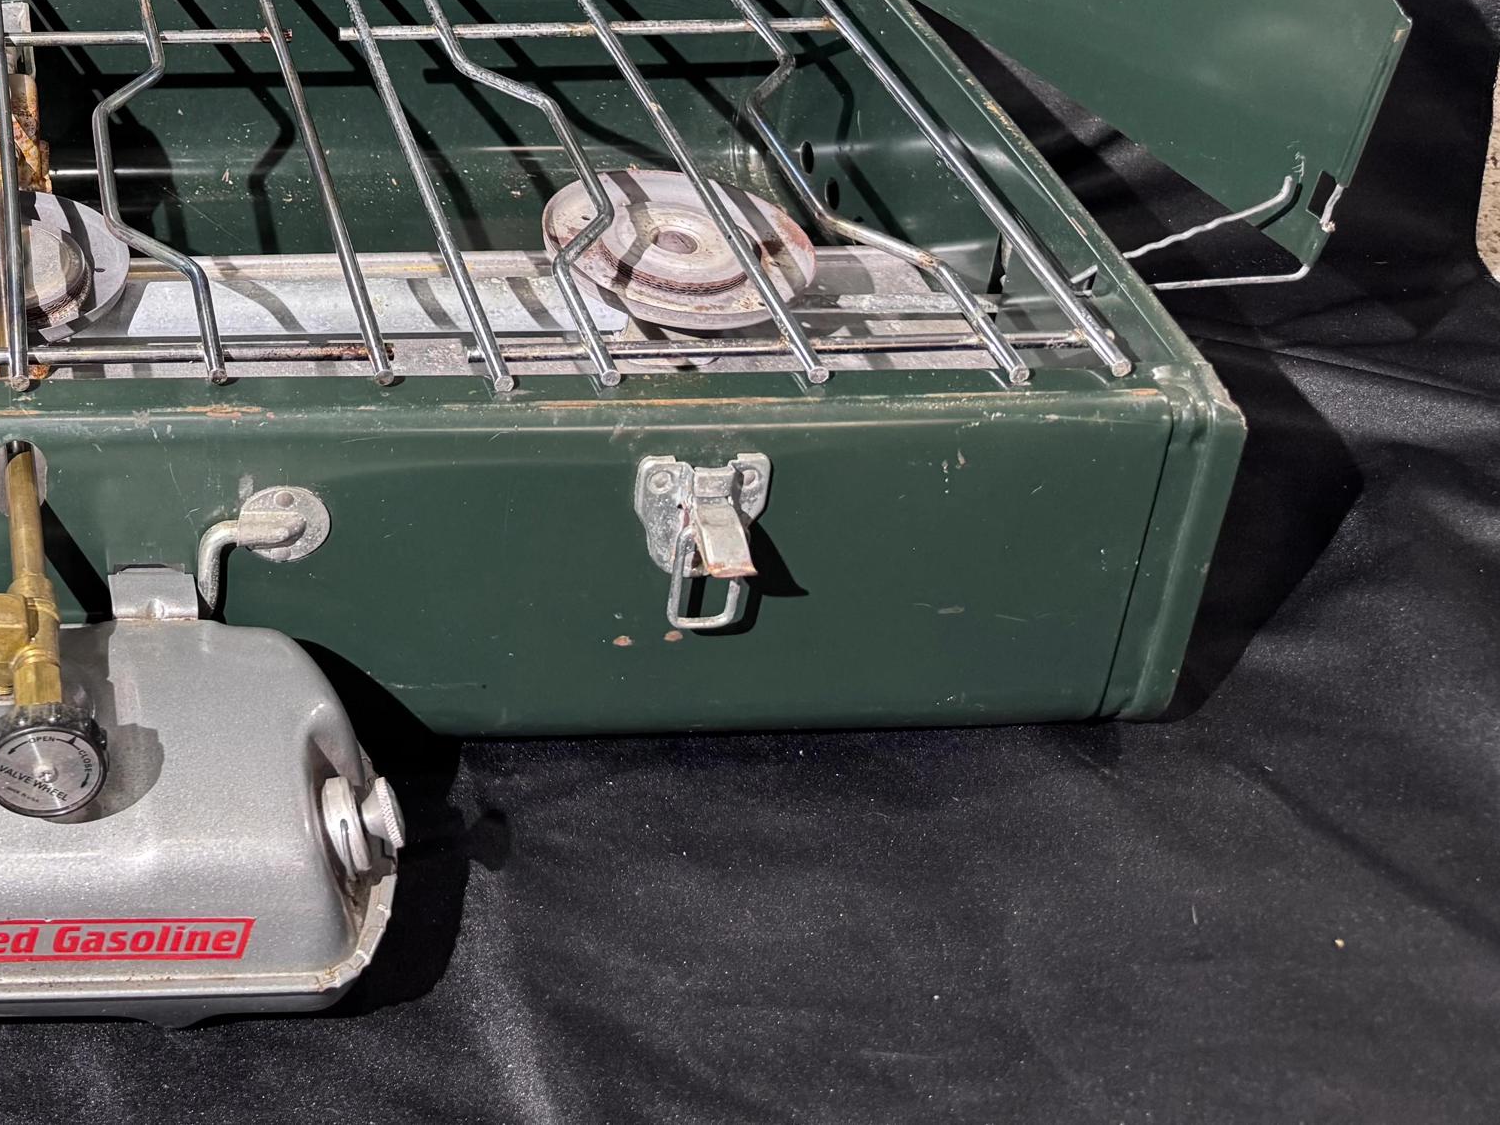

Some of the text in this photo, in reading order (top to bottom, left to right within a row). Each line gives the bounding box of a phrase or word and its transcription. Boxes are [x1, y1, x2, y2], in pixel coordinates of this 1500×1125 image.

[28, 735, 57, 743] OPEN
[78, 749, 93, 772] CLOSE
[0, 765, 33, 784] VALVE
[33, 780, 68, 801] WHEEL
[52, 925, 238, 953] Gasoline
